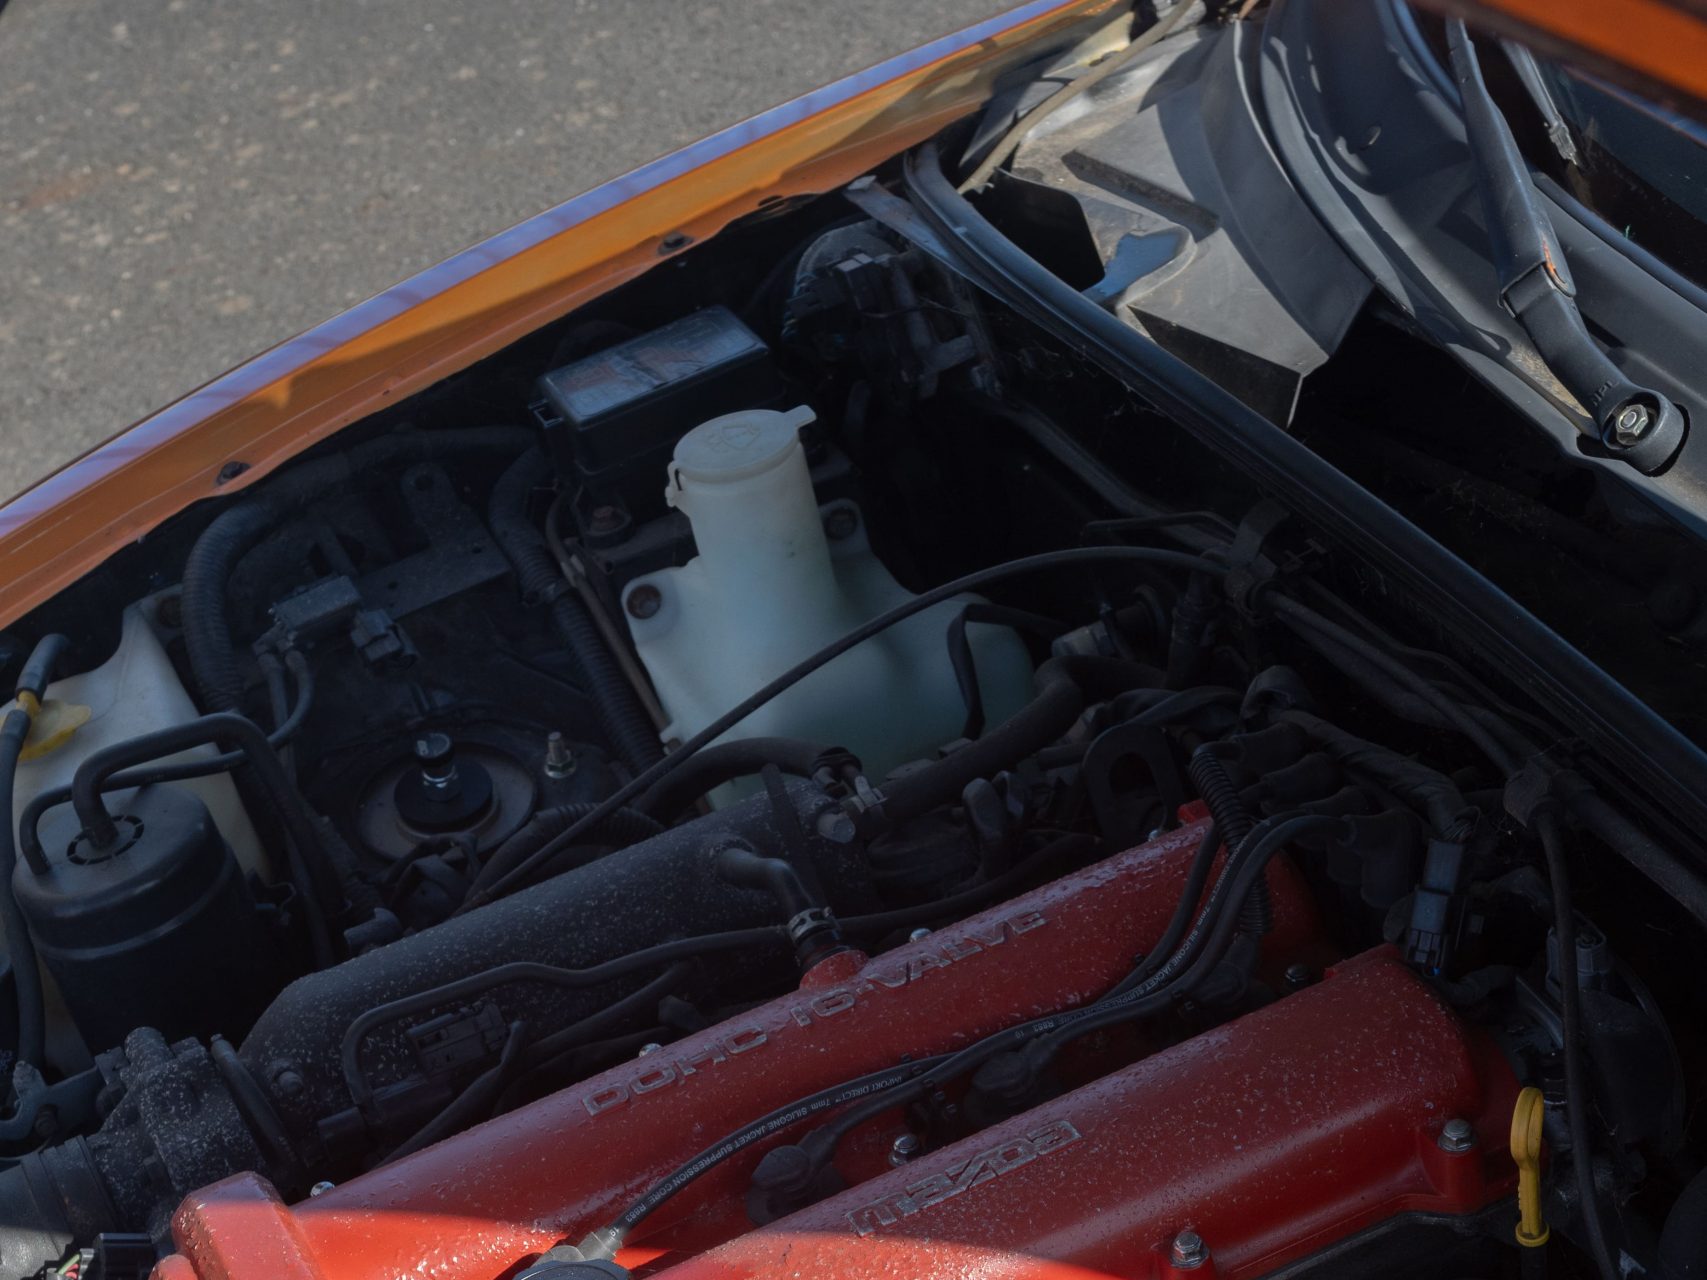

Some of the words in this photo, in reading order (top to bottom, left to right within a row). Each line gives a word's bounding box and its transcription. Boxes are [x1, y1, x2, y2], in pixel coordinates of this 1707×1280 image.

[582, 1023, 768, 1117] DOHC
[768, 1106, 808, 1131] SILICONE
[735, 1124, 767, 1149] JACKET
[673, 1143, 734, 1187] SUPPRESSION
[648, 1183, 673, 1205] CORE
